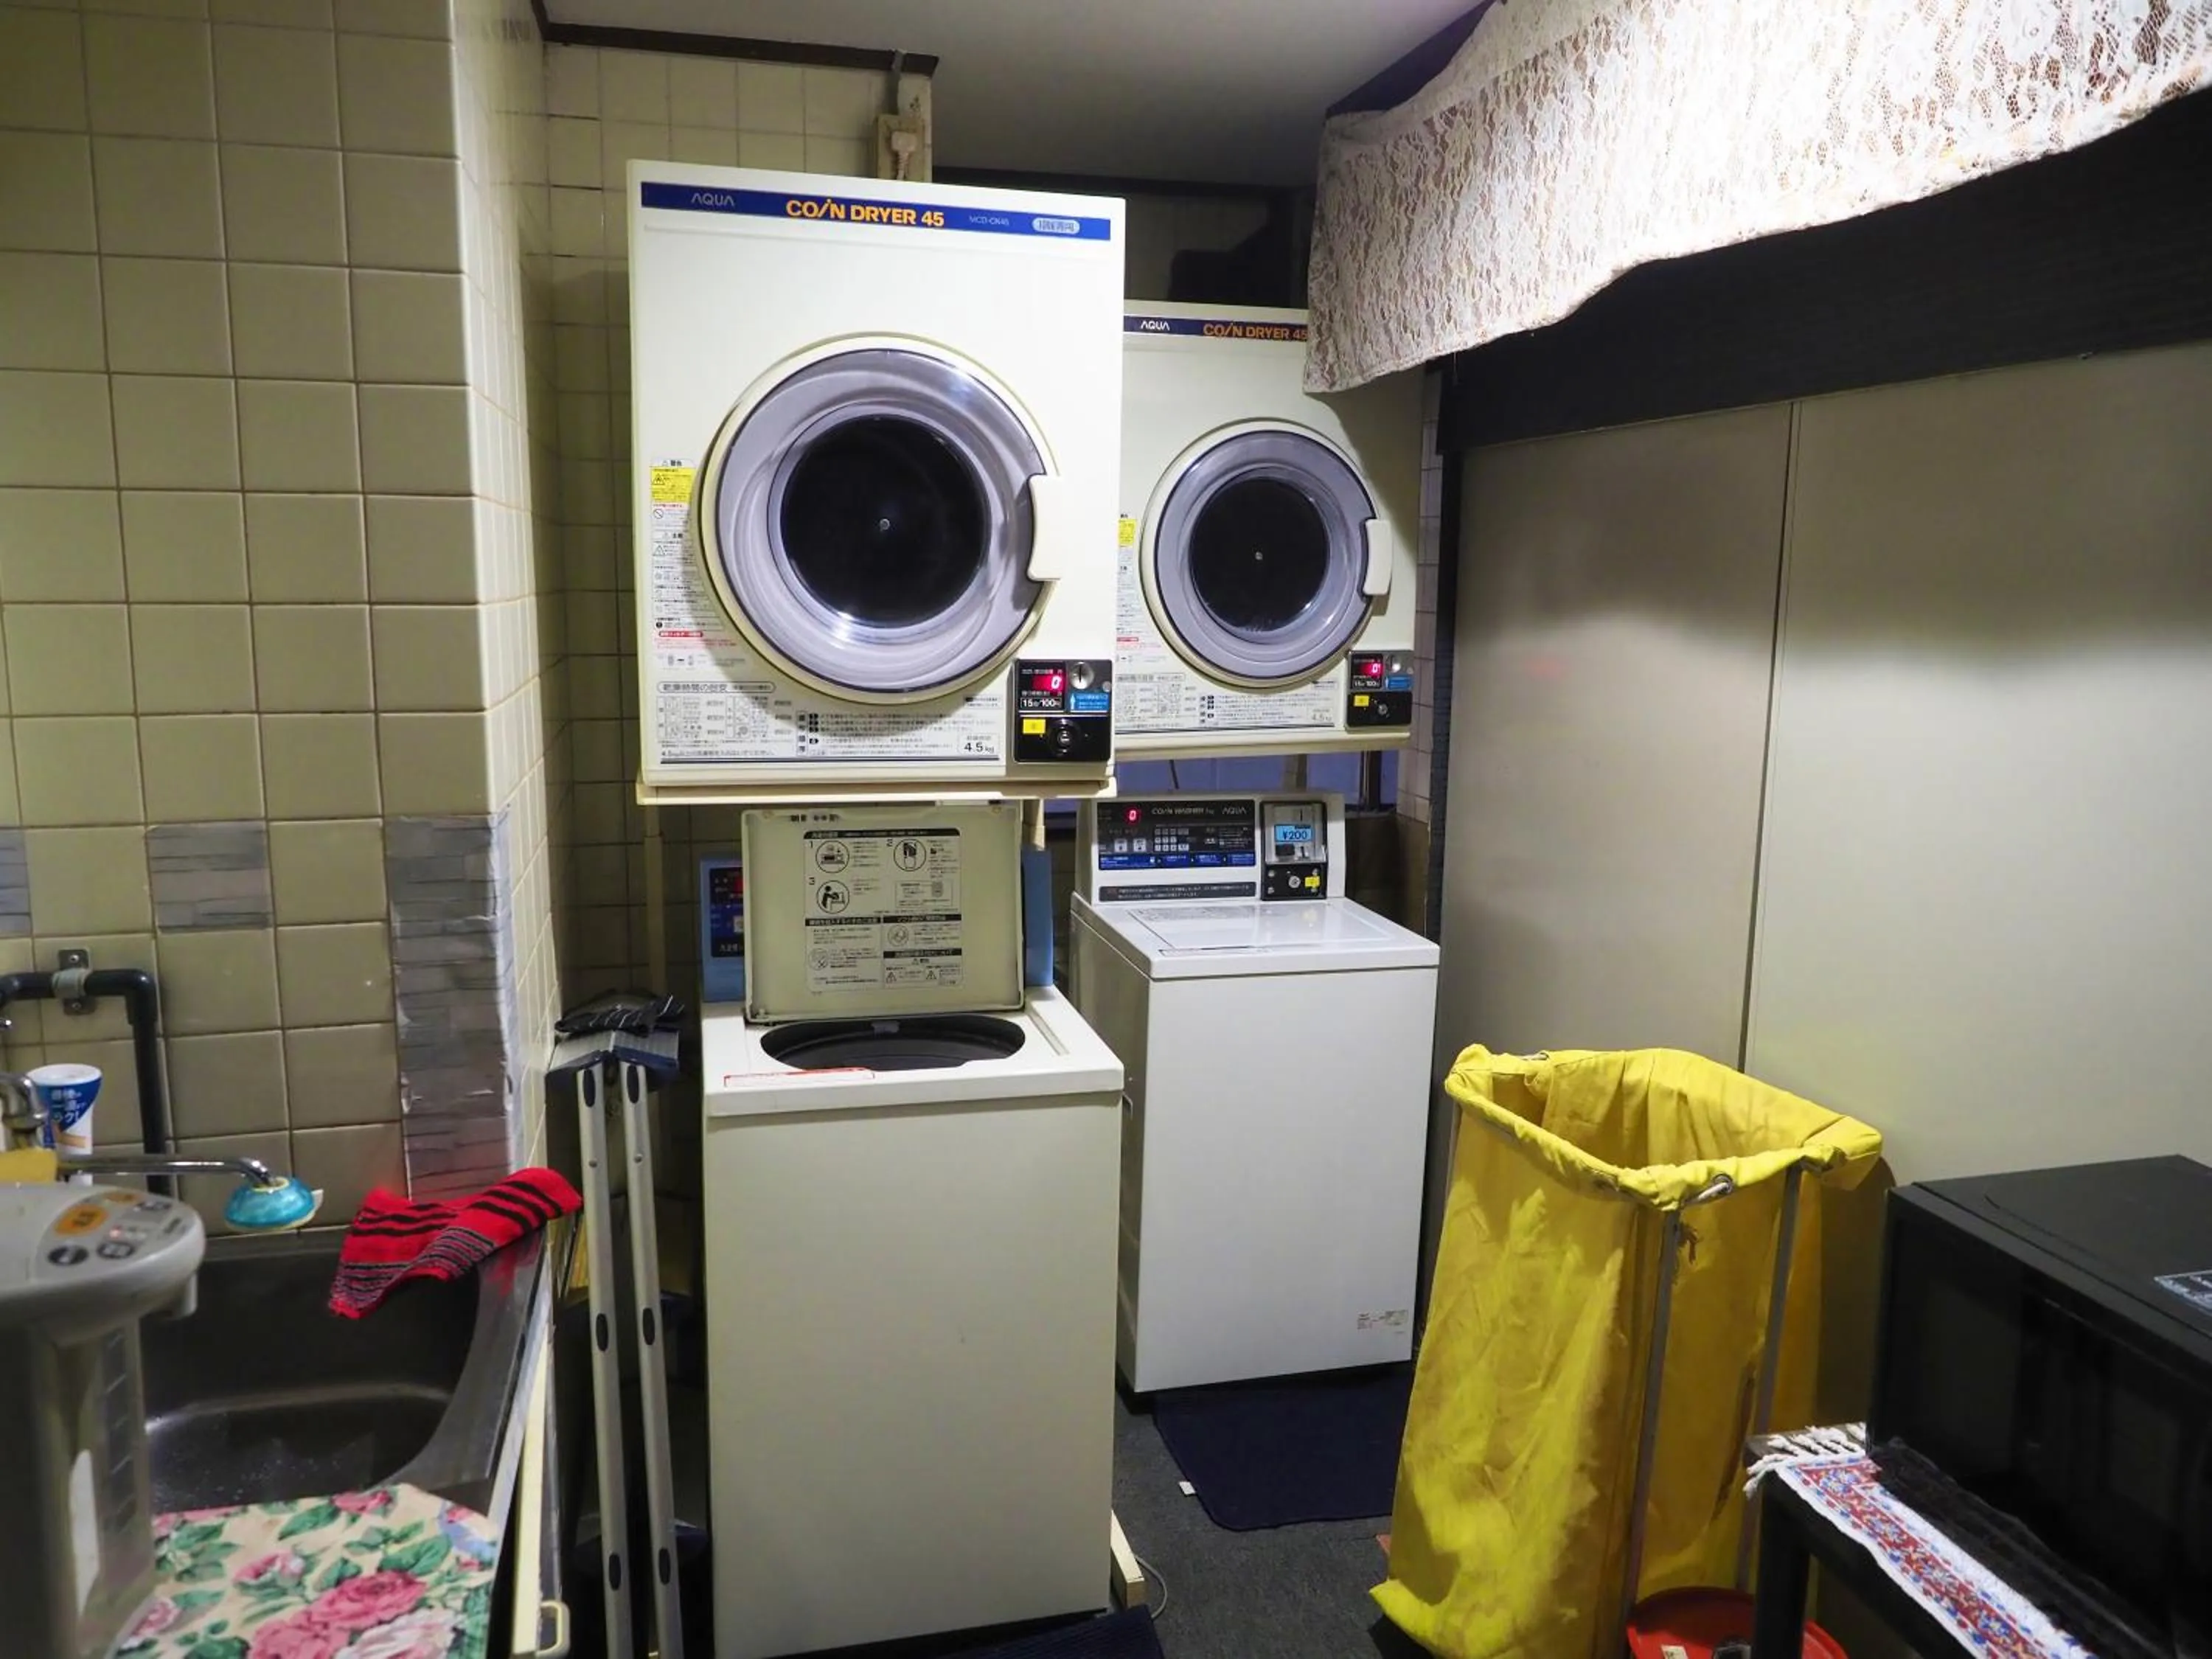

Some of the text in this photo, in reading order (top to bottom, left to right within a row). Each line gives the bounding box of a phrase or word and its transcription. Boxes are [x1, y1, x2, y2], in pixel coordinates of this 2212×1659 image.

[691, 192, 735, 206] AQUA
[850, 204, 917, 225] DRYER
[921, 211, 945, 227] 45
[1141, 320, 1170, 331] AQUA
[1245, 327, 1290, 340] DRYER
[1293, 329, 1307, 341] 45
[1372, 663, 1379, 673] 0
[1051, 675, 1061, 689] 0
[1128, 810, 1137, 821] 0
[1221, 806, 1248, 815] AQUA
[1283, 830, 1307, 840] ¥200
